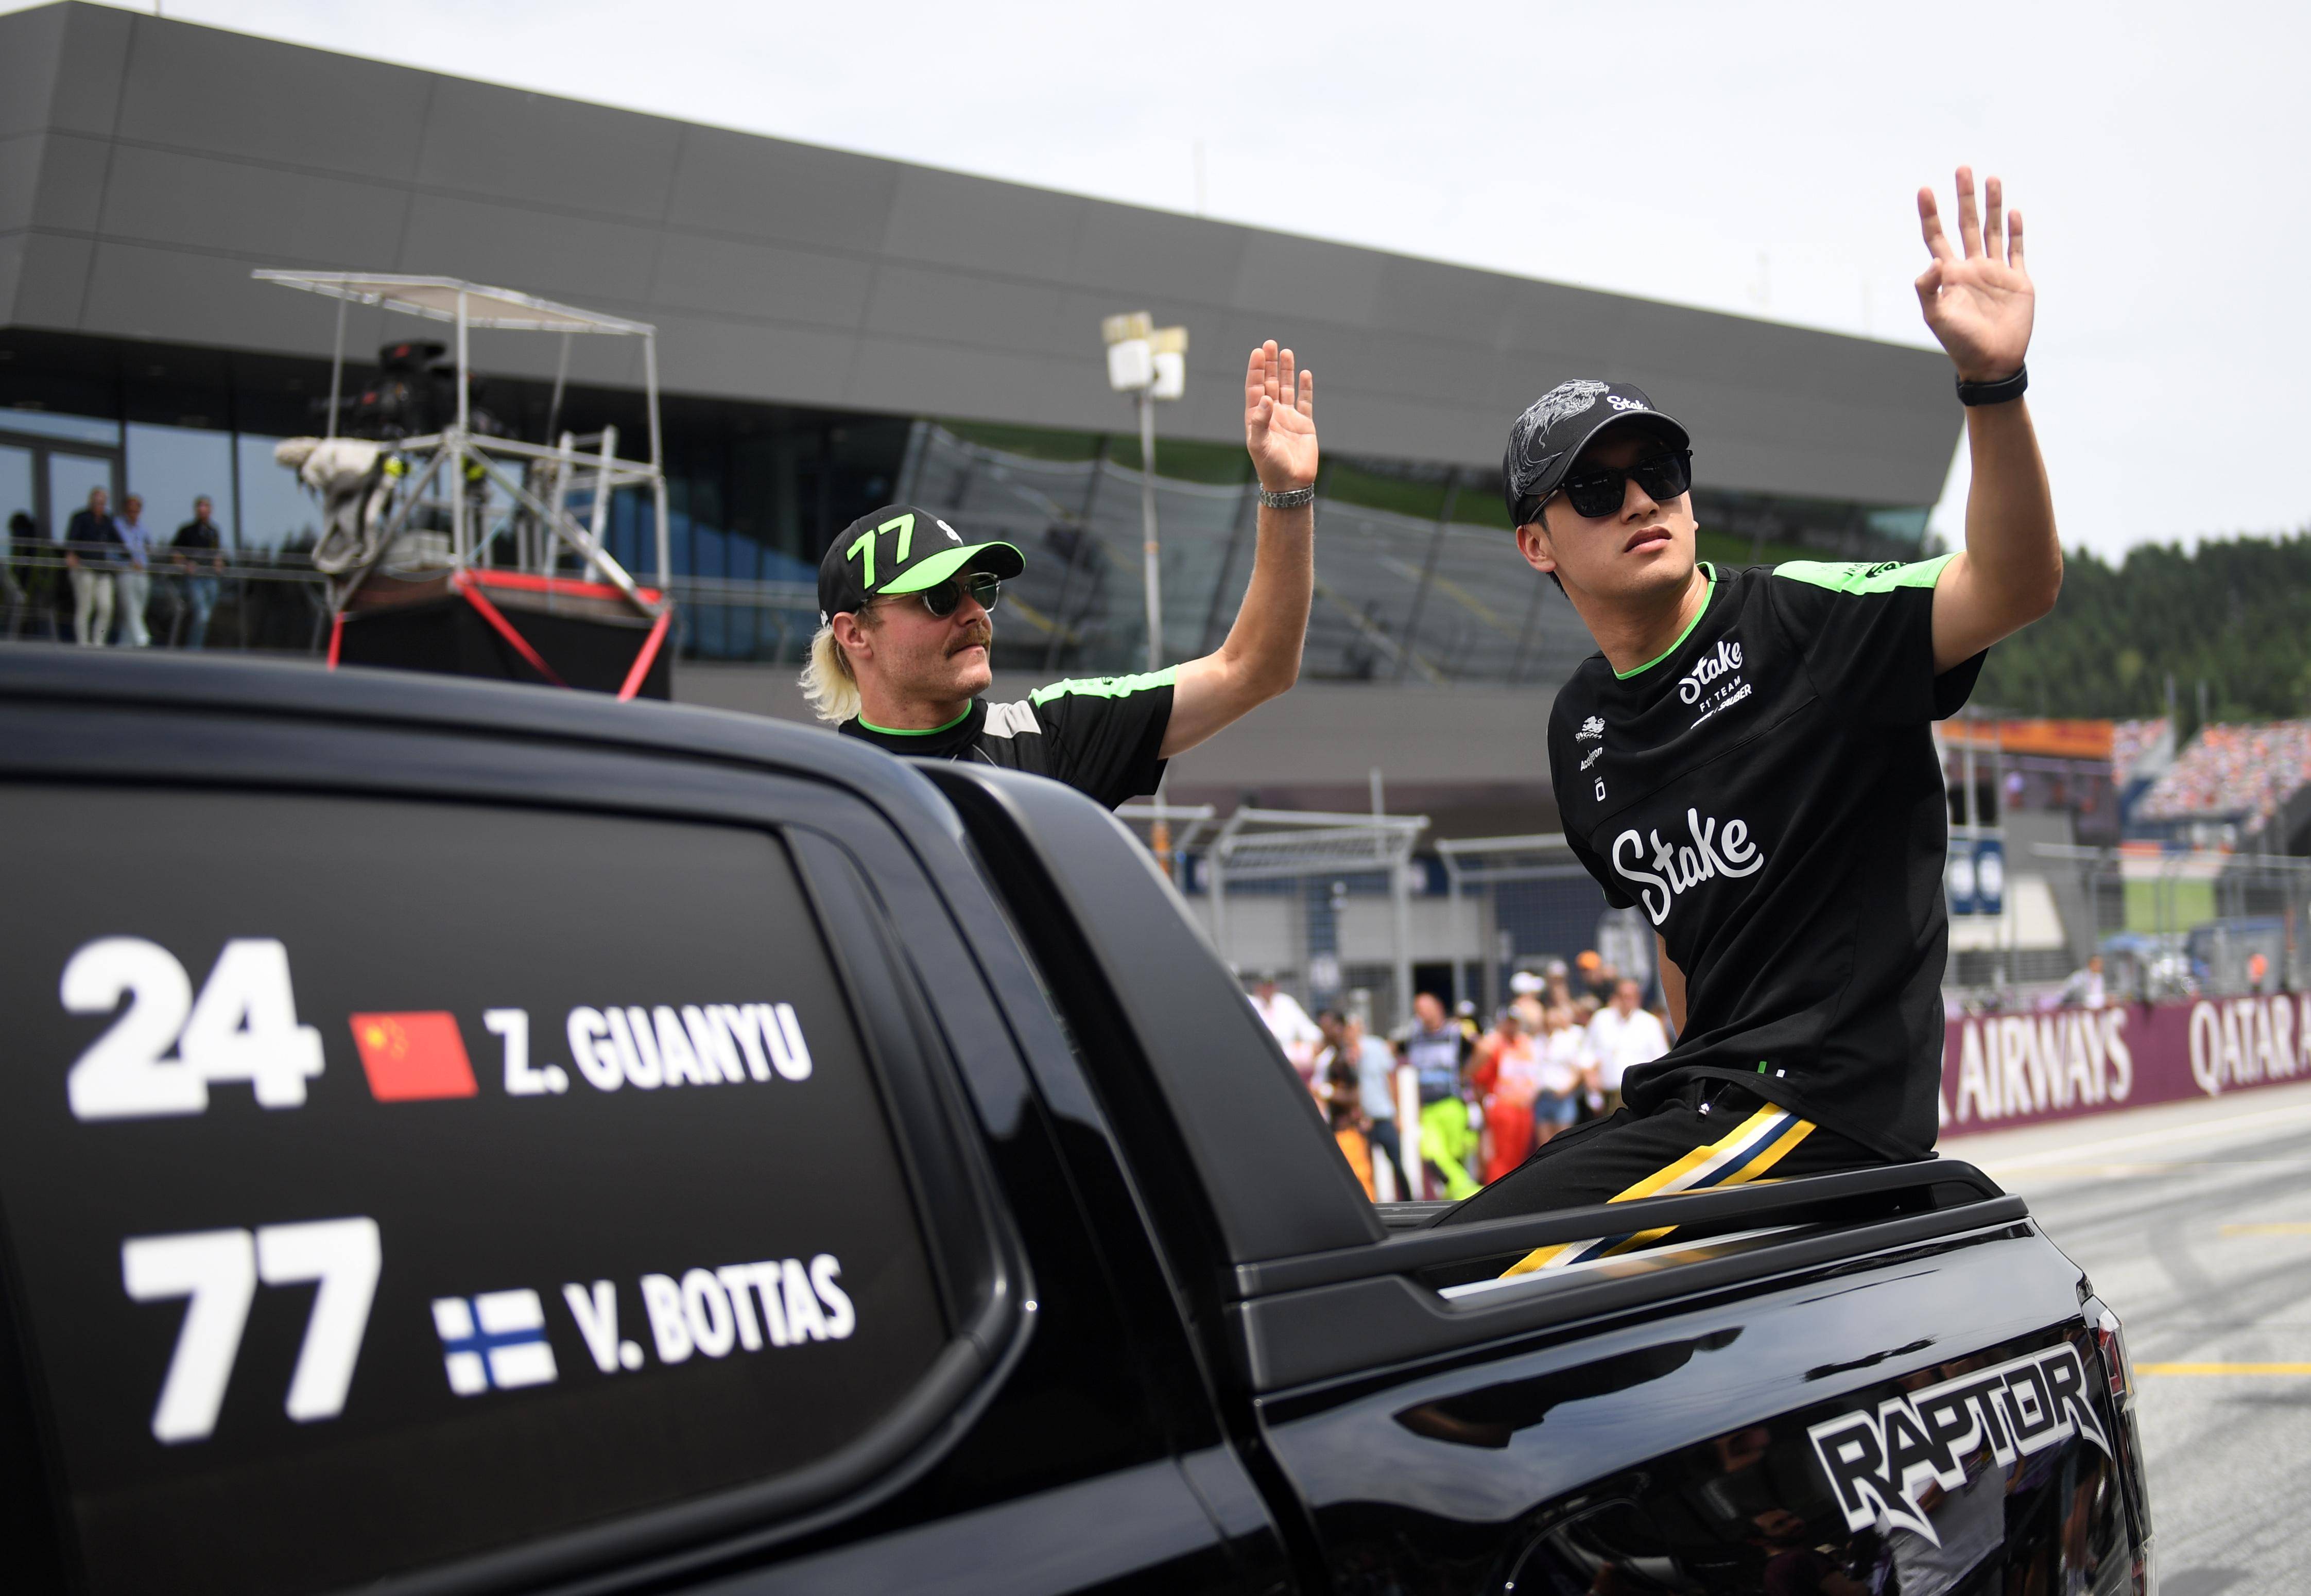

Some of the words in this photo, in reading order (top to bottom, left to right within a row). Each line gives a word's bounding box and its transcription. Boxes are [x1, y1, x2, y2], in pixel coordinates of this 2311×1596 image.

[847, 513, 916, 590] 77
[1714, 675, 1741, 701] TEAM
[1612, 807, 1765, 926] Stake
[60, 936, 325, 1121] 24
[483, 1008, 567, 1095] Z.
[566, 1002, 813, 1091] GUANYU
[1955, 1007, 2132, 1124] AIRWAYS
[2188, 995, 2296, 1098] QATAR
[122, 1216, 382, 1443] 77
[564, 1279, 644, 1373] V.
[641, 1253, 856, 1363] BOTTAS
[1807, 1341, 2113, 1549] RAPTOR
